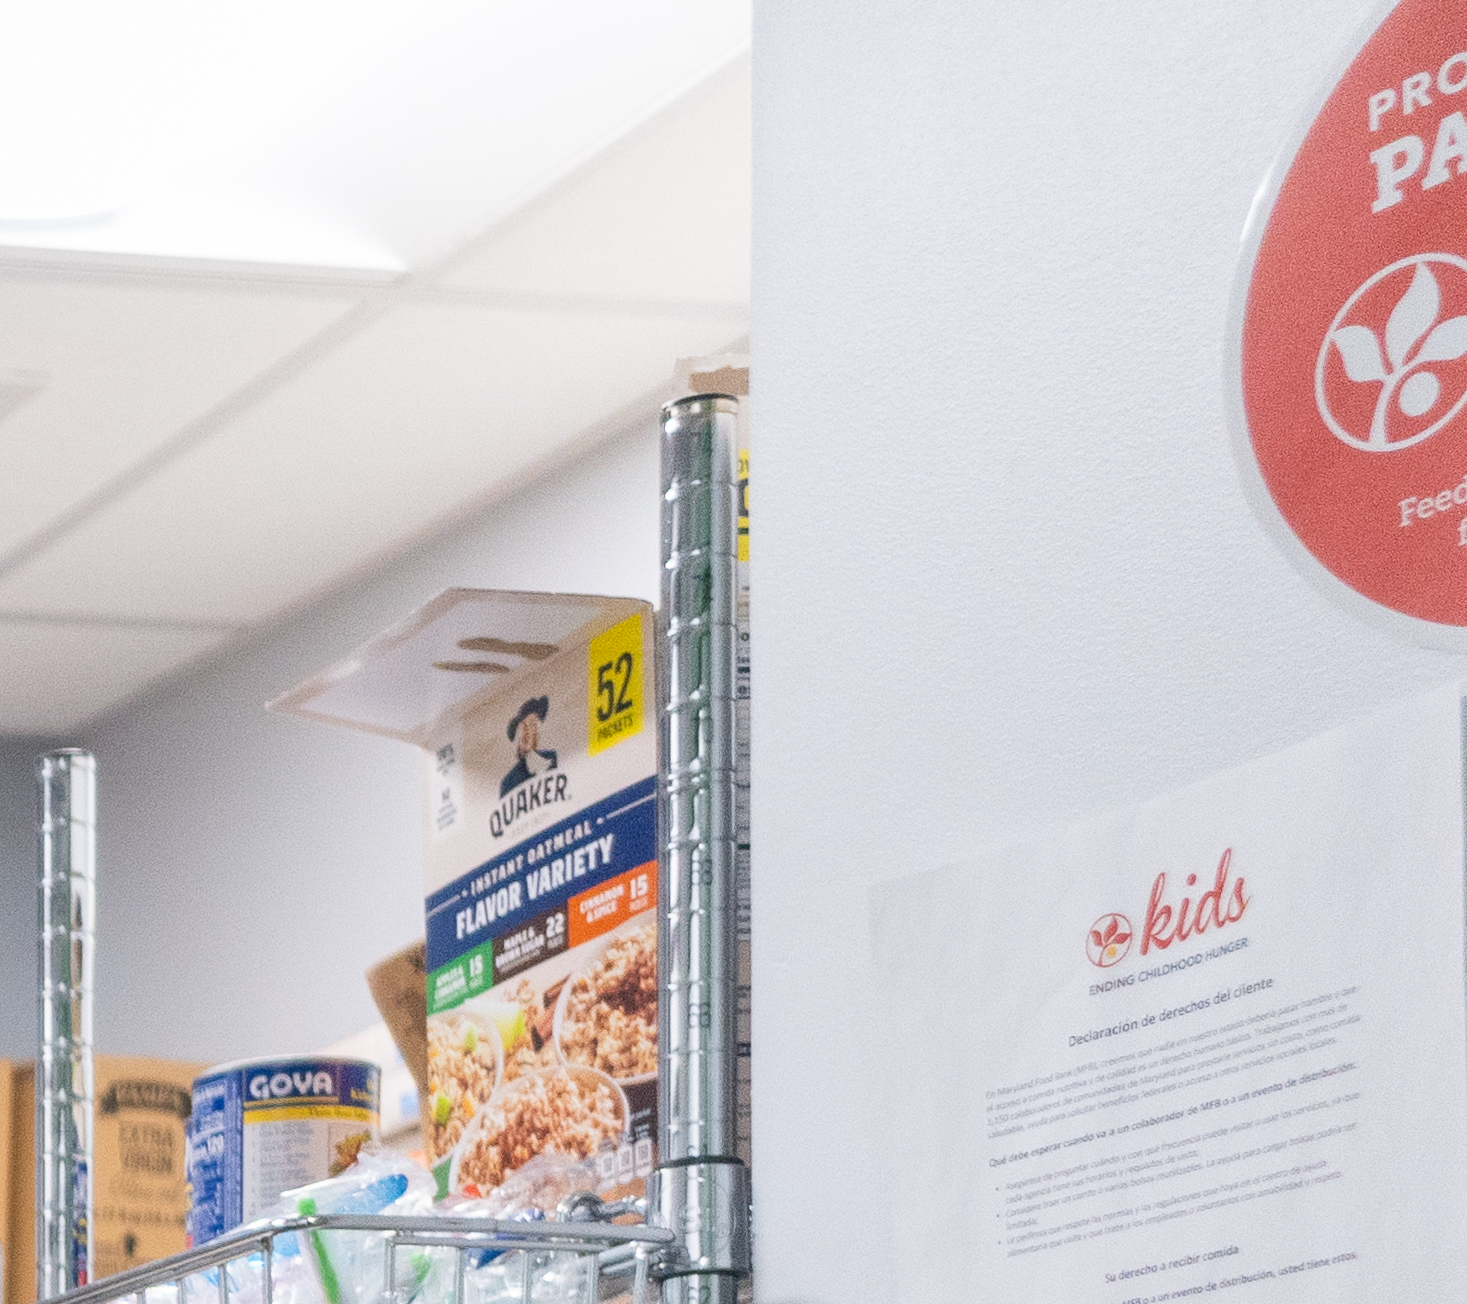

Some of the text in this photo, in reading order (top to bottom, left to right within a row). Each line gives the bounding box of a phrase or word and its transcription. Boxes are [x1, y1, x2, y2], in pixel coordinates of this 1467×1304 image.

[597, 651, 633, 723] 52
[596, 717, 634, 744] PACKETS
[489, 772, 569, 840] QUAKER
[470, 821, 593, 897] INSTANT OATMEAL
[456, 833, 615, 941] FLAVOR VARIETY
[630, 873, 648, 900] 15
[1140, 847, 1252, 956] kids
[546, 912, 565, 938] 22
[469, 954, 483, 979] 15
[1088, 935, 1249, 998] ENDING CHILDHOOD HUNGER
[1068, 1015, 1138, 1048] Declaración
[1158, 994, 1210, 1022] derechos
[1212, 987, 1231, 1006] del
[1233, 974, 1273, 999] cliente
[249, 1071, 333, 1099] GOYA
[1008, 1148, 1028, 1163] debe
[1030, 1140, 1061, 1158] esperar
[1118, 1261, 1157, 1280] derecho
[1168, 1252, 1200, 1269] recibir
[1202, 1243, 1238, 1262] comida
